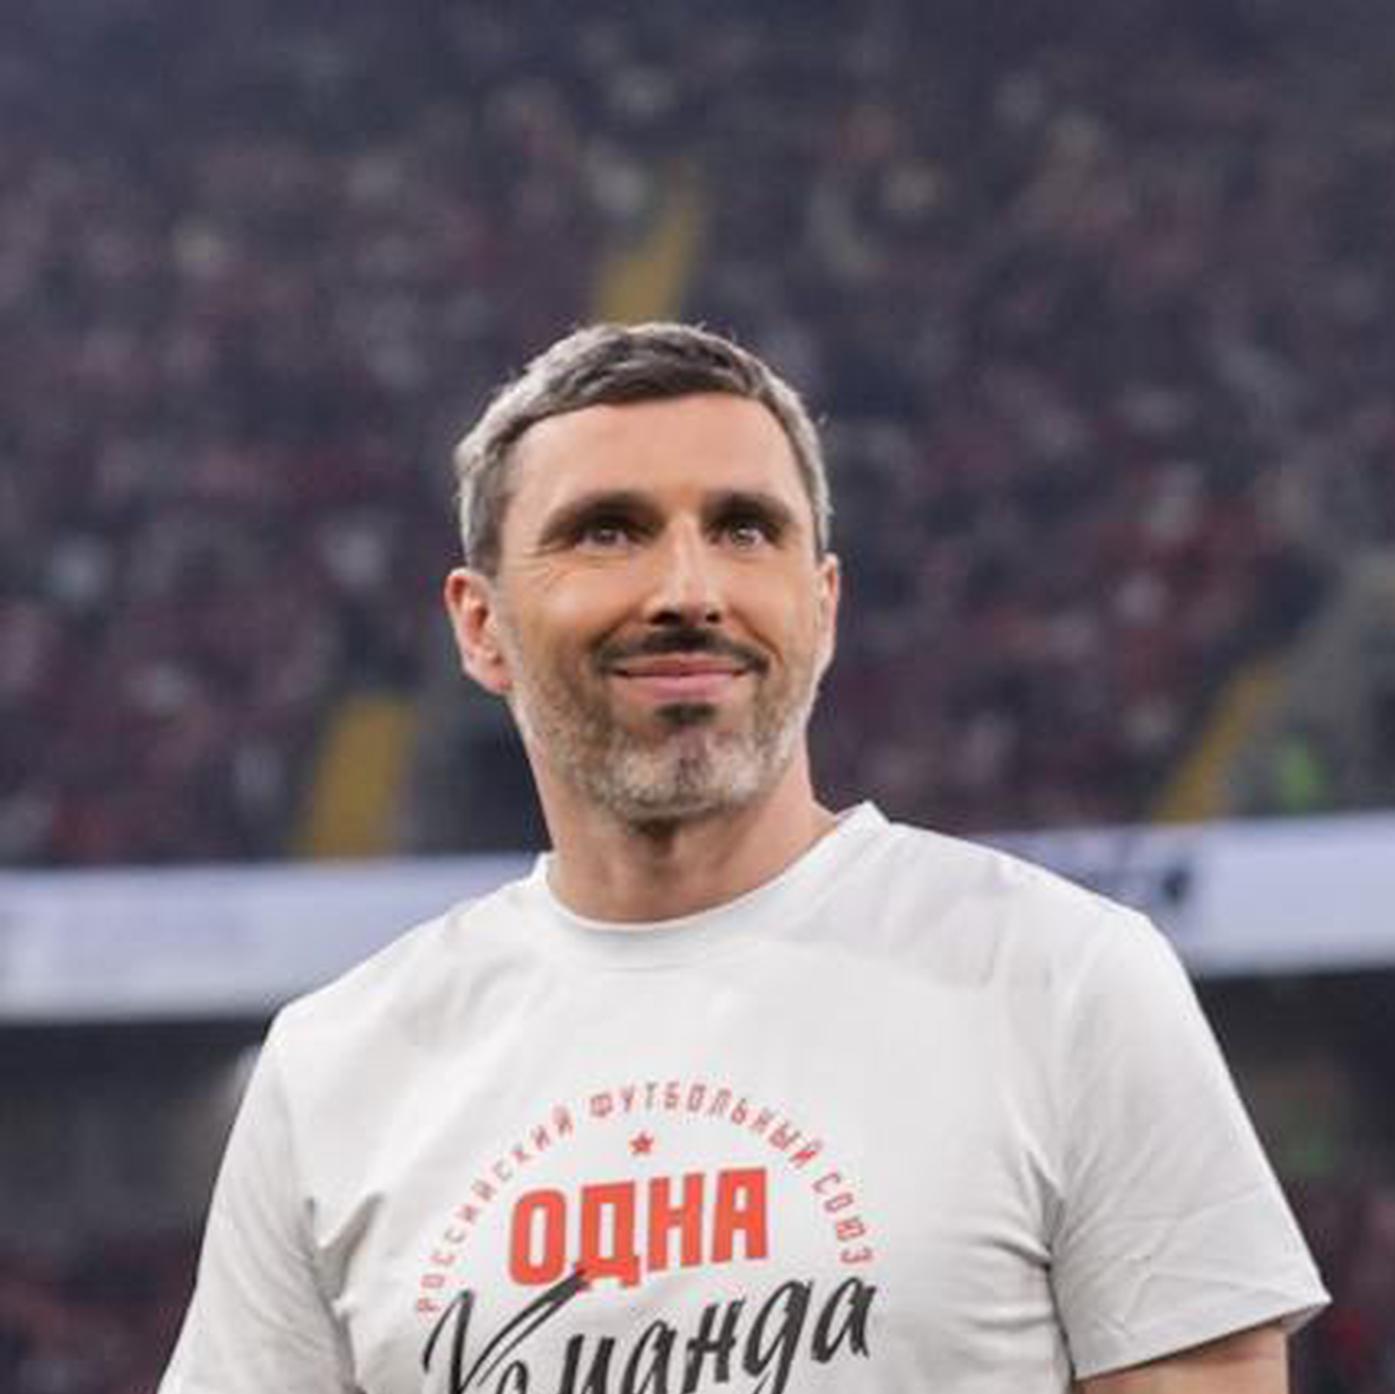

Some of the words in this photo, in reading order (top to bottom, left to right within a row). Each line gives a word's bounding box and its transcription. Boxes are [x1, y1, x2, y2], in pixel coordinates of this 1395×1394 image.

[416, 1105, 576, 1314] РОССИЙСКИЙ
[588, 1080, 822, 1168] ФУТБОЛЬНЫЙ
[811, 1171, 875, 1268] СОЮЗ
[508, 1167, 769, 1287] ОДНА
